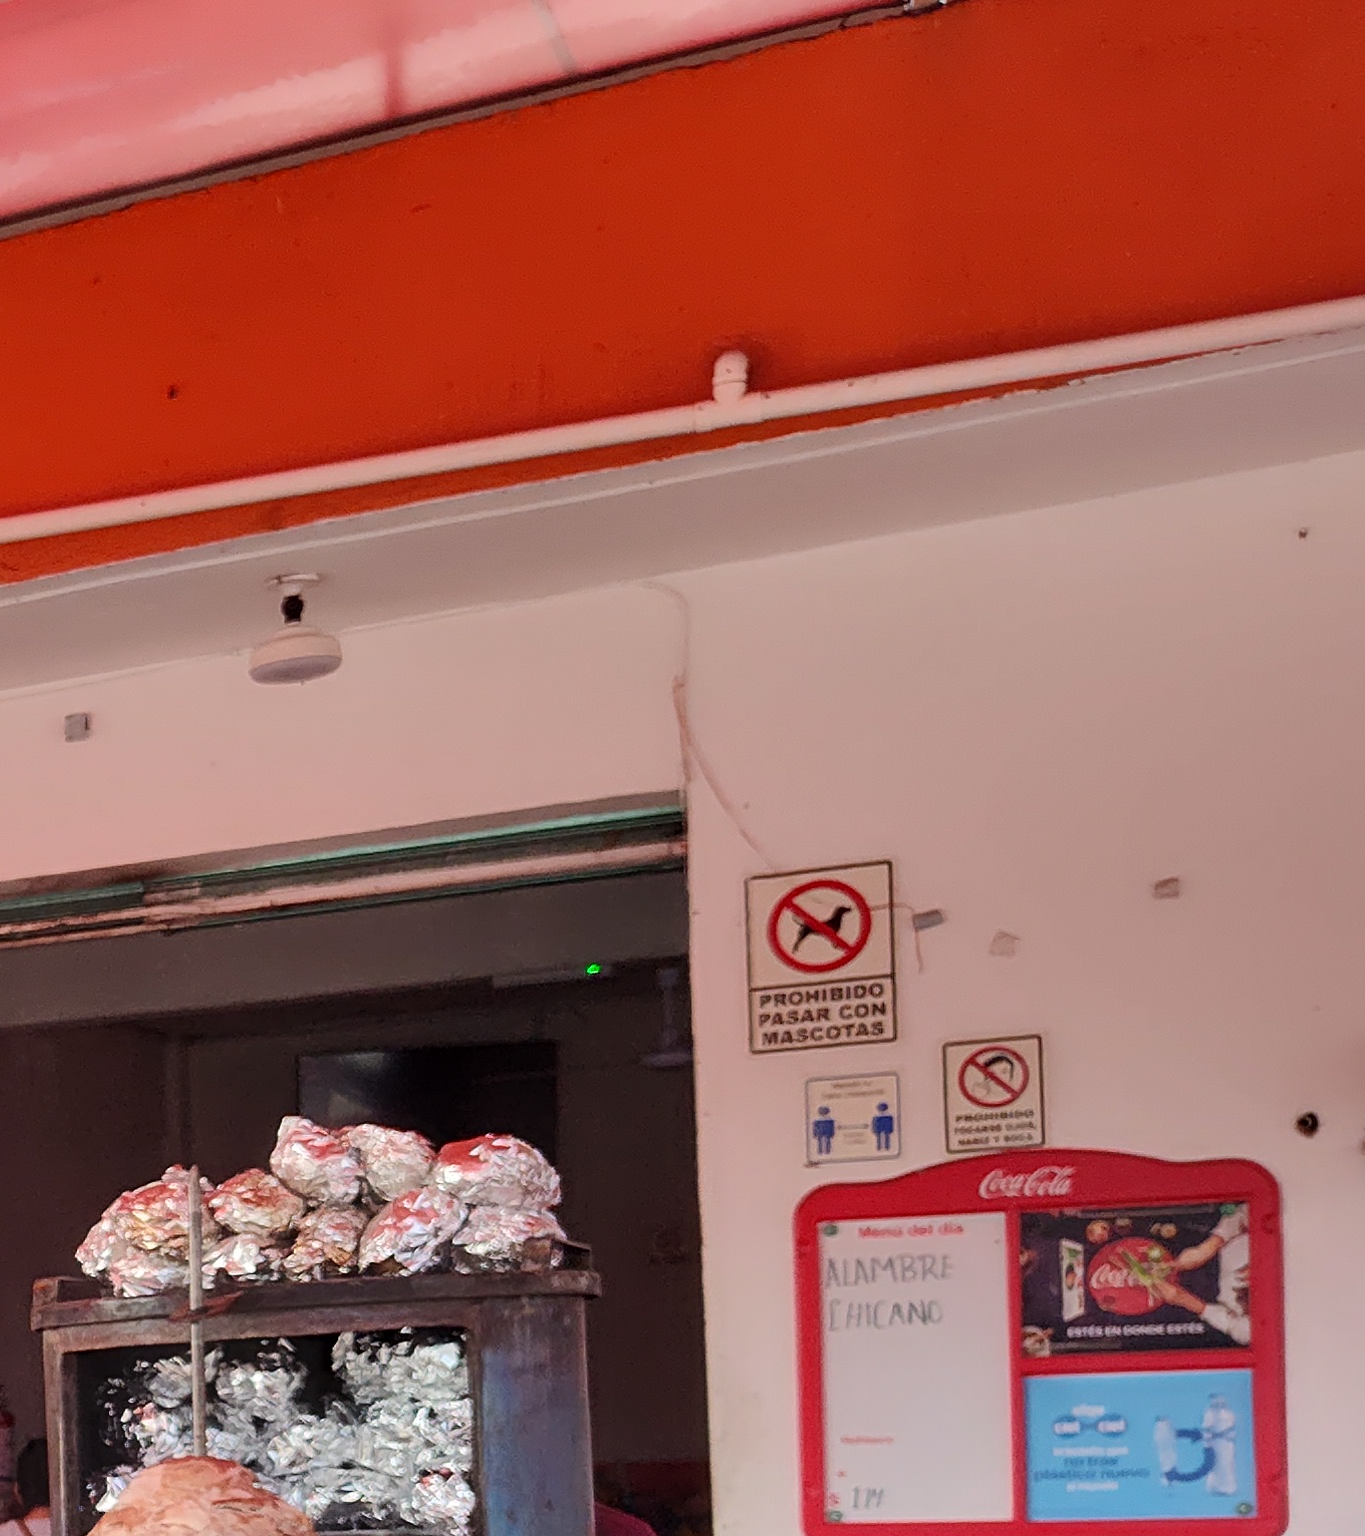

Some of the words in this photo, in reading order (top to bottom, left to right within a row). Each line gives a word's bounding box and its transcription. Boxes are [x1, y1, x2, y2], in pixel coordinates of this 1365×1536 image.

[759, 982, 885, 1008] PROHIBIDO
[758, 1007, 831, 1027] PASAR
[839, 1002, 887, 1020] CON
[761, 1021, 885, 1046] MASCOTAS
[977, 1165, 1077, 1200] Coca-Cola
[825, 1253, 954, 1289] ALAMBRE
[827, 1298, 945, 1332] CHICANO
